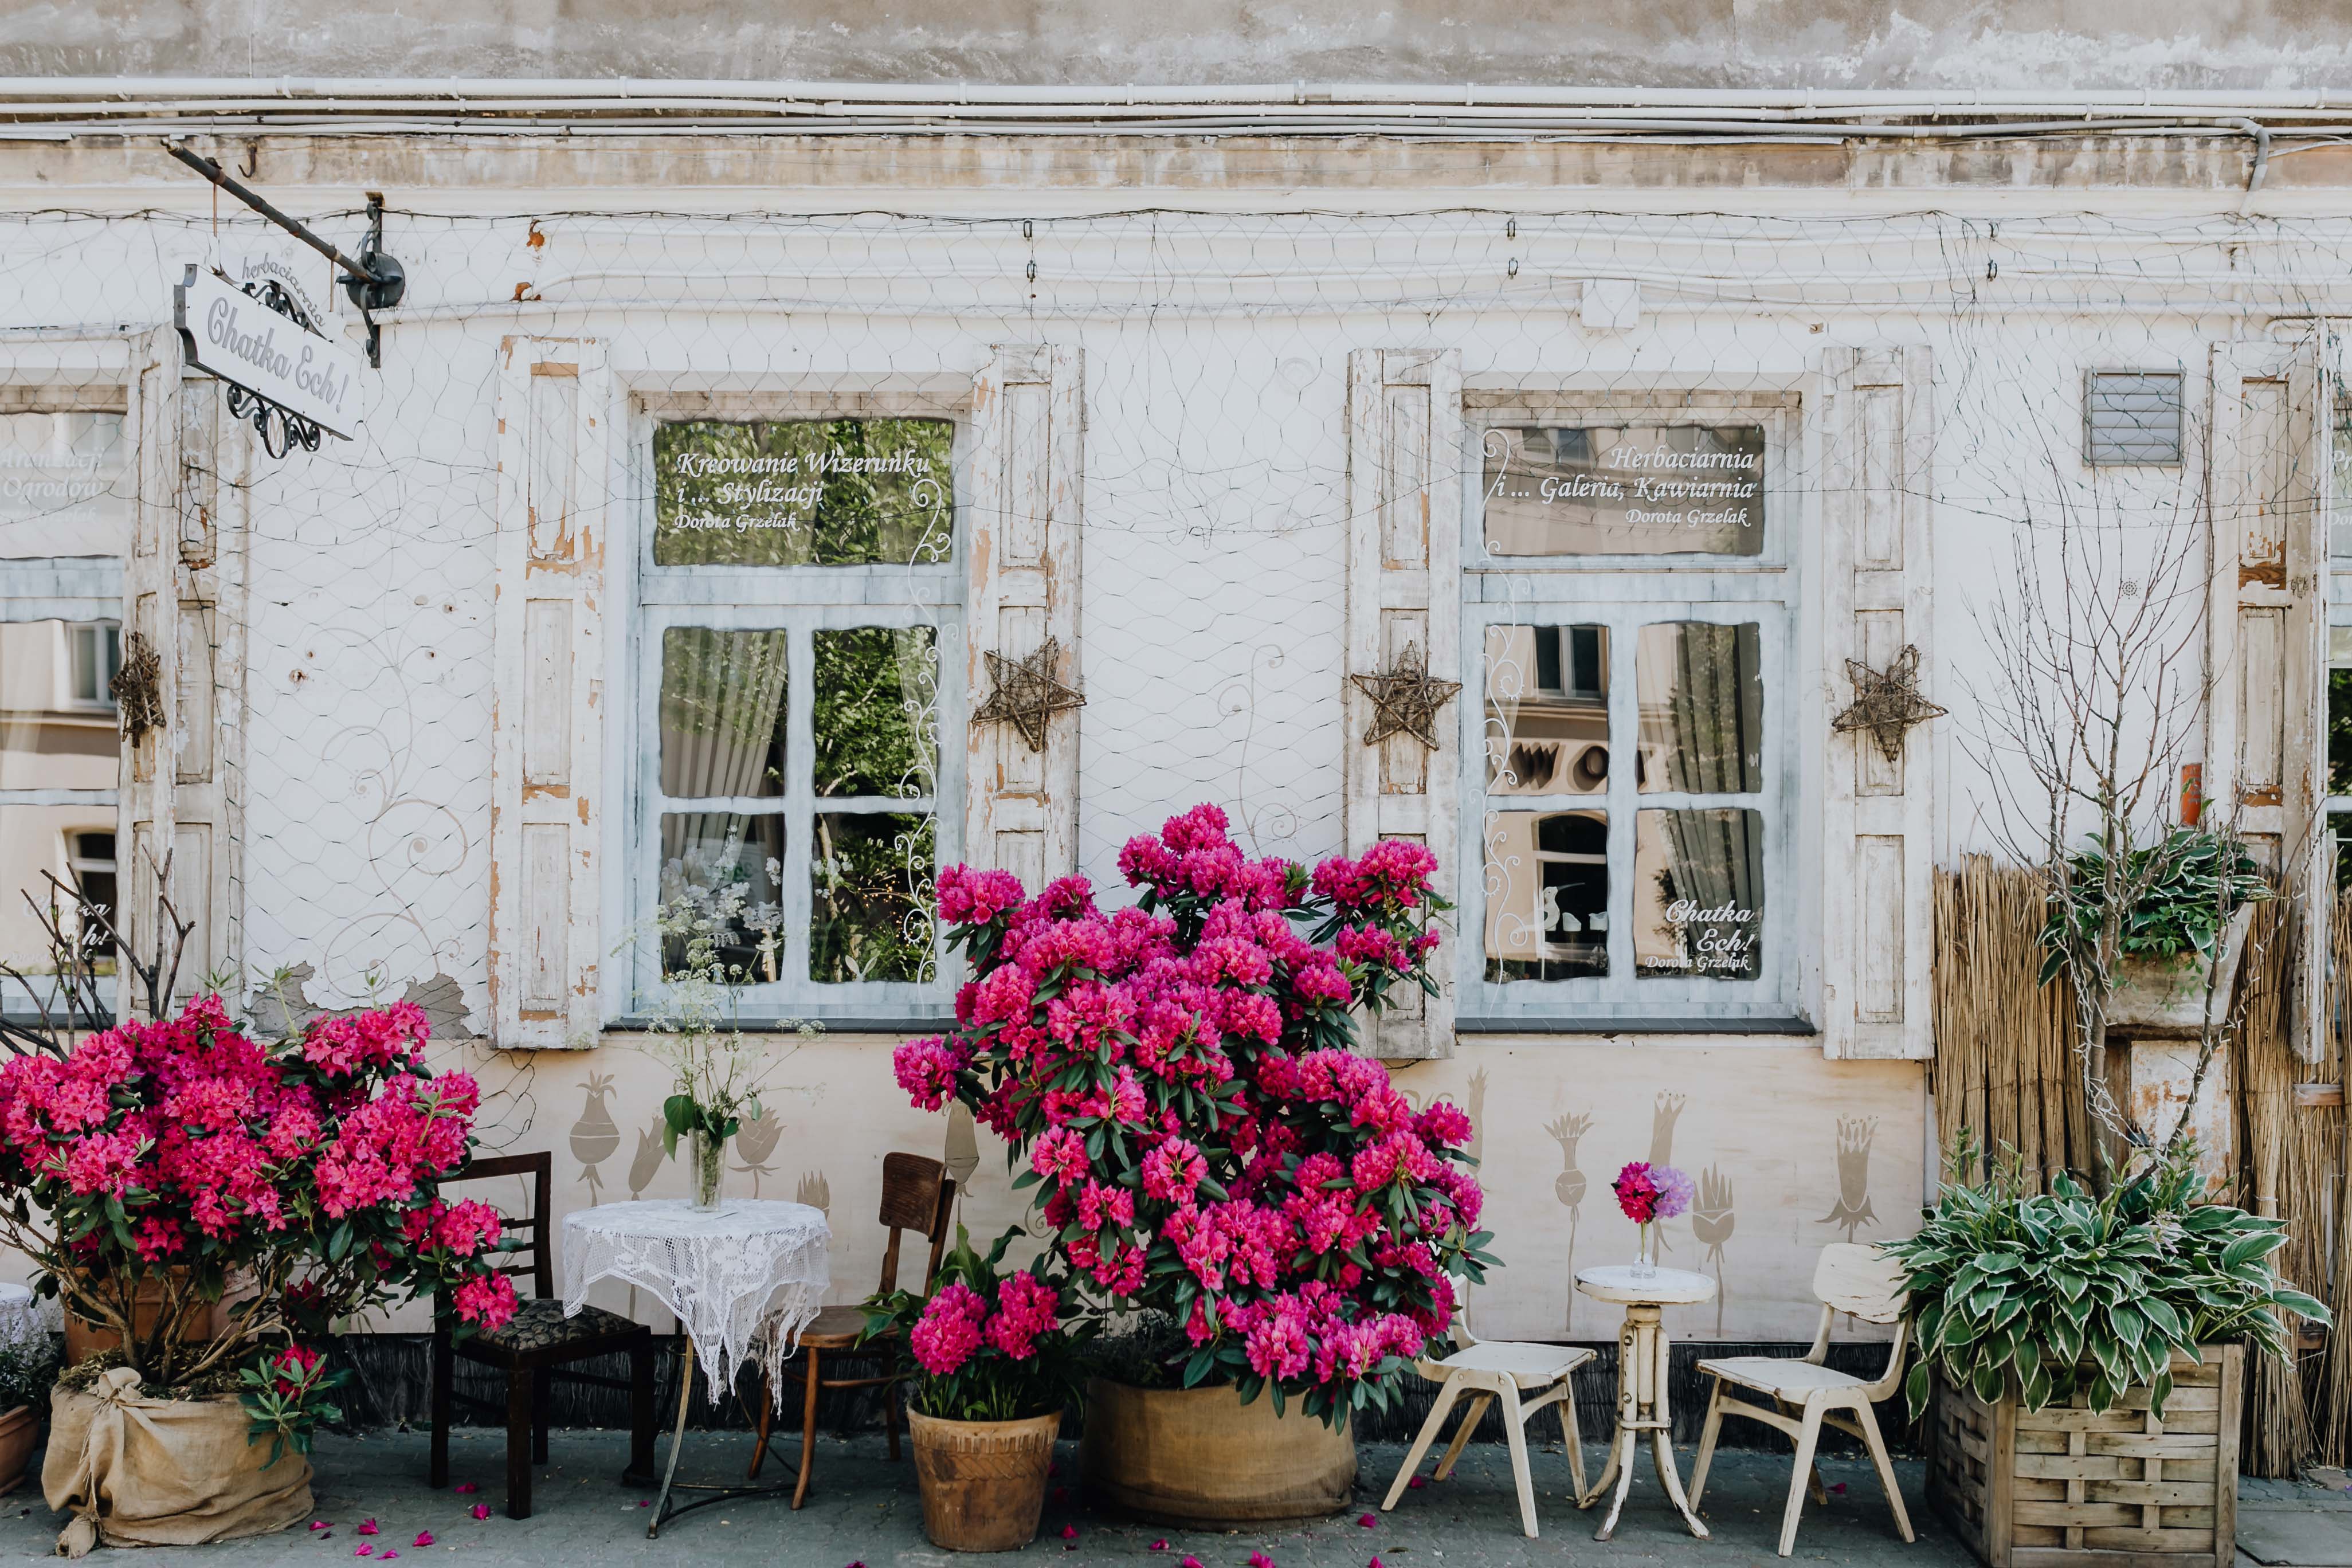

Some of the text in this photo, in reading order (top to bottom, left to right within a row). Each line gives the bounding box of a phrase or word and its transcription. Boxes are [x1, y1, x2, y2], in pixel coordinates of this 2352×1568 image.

[242, 252, 326, 327] herbaciarnia
[207, 297, 349, 413] Chatka Ech!
[677, 449, 930, 478] Kreowanie Wizerunku
[1609, 445, 1754, 469] Herbaciarnia
[717, 479, 823, 510] Stylizacji
[1540, 474, 1624, 504] Galeria,
[1634, 476, 1754, 502] Kawiarnia
[674, 511, 801, 533] Dorota Grzelak
[1625, 508, 1751, 528] Dorota Grzelak
[1665, 899, 1755, 923] Chatka
[1696, 928, 1755, 952] Ech!
[1645, 955, 1752, 973] Doroa Grzelak
